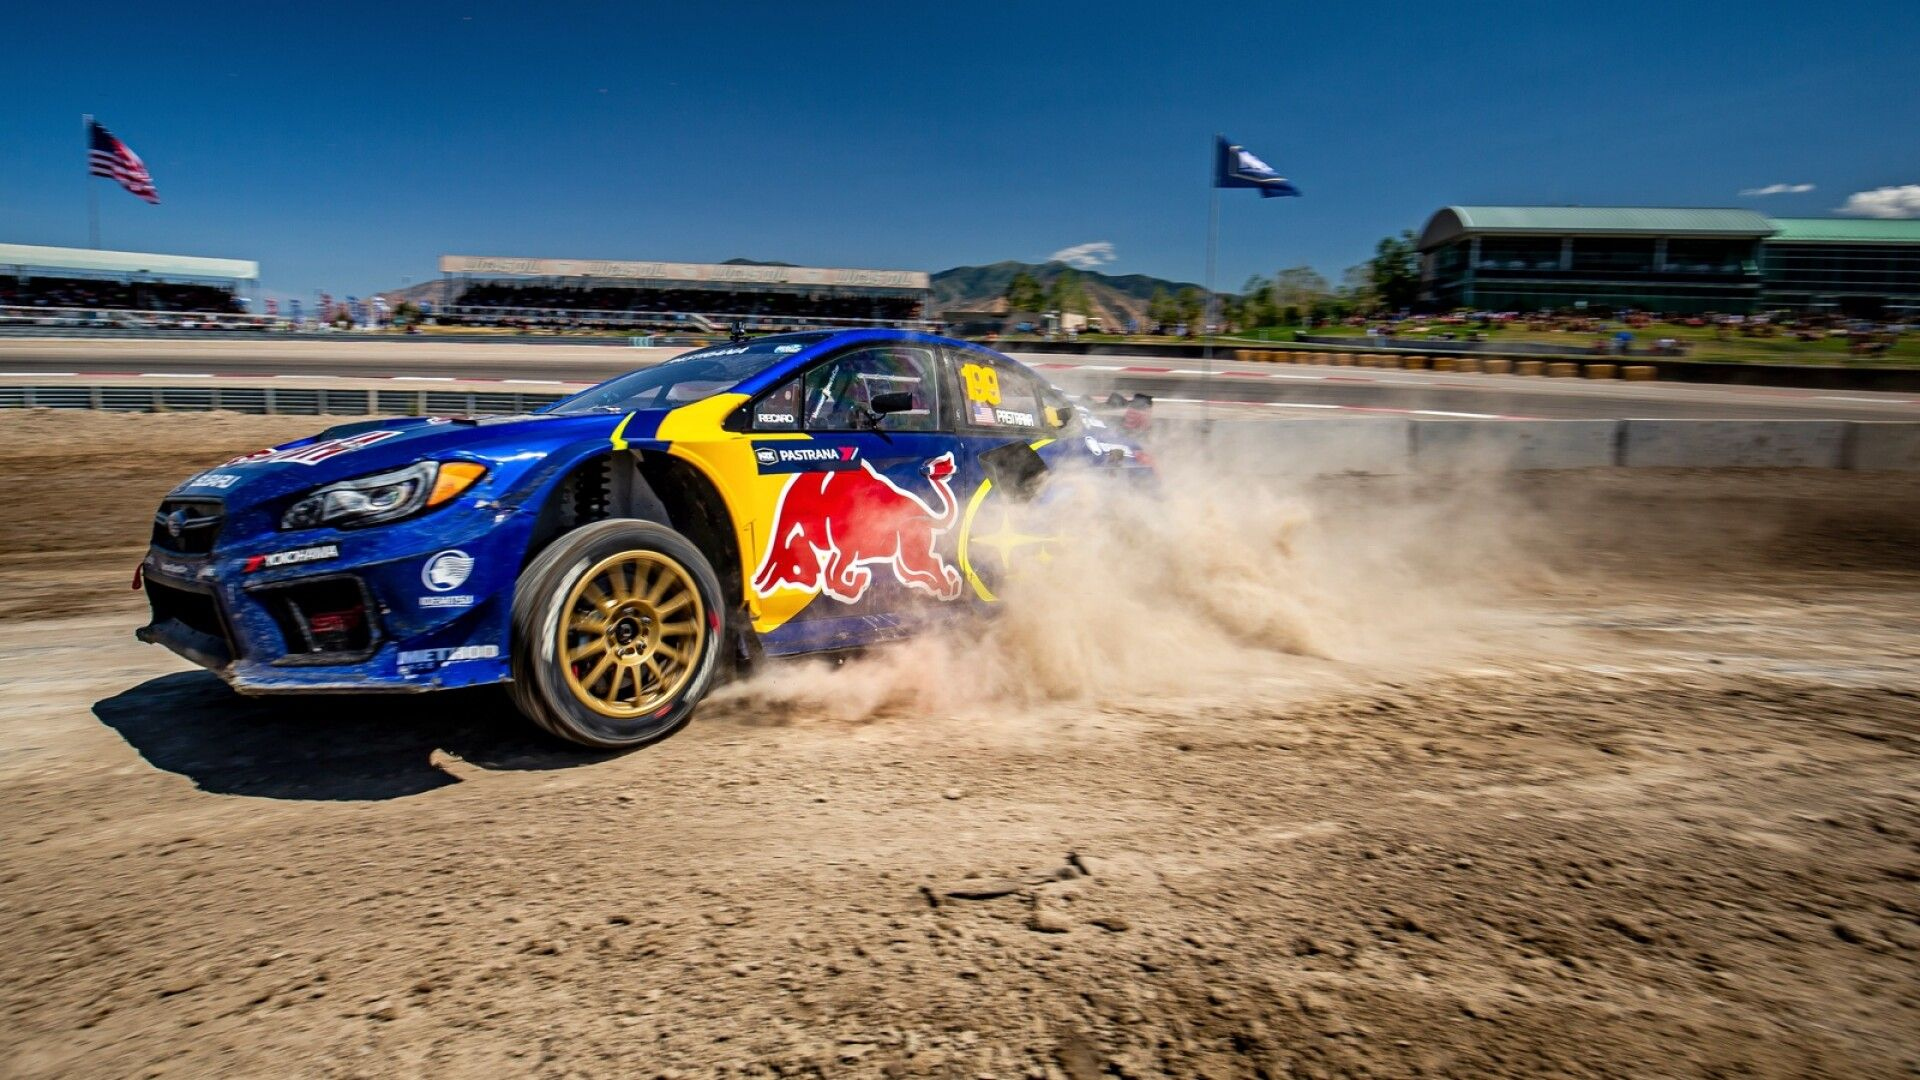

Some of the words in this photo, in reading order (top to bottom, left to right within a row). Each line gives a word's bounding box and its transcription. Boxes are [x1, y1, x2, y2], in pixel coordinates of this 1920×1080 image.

[757, 413, 794, 423] RECARO
[779, 448, 840, 461] PASTRANA
[264, 544, 339, 568] YOKOHAMA
